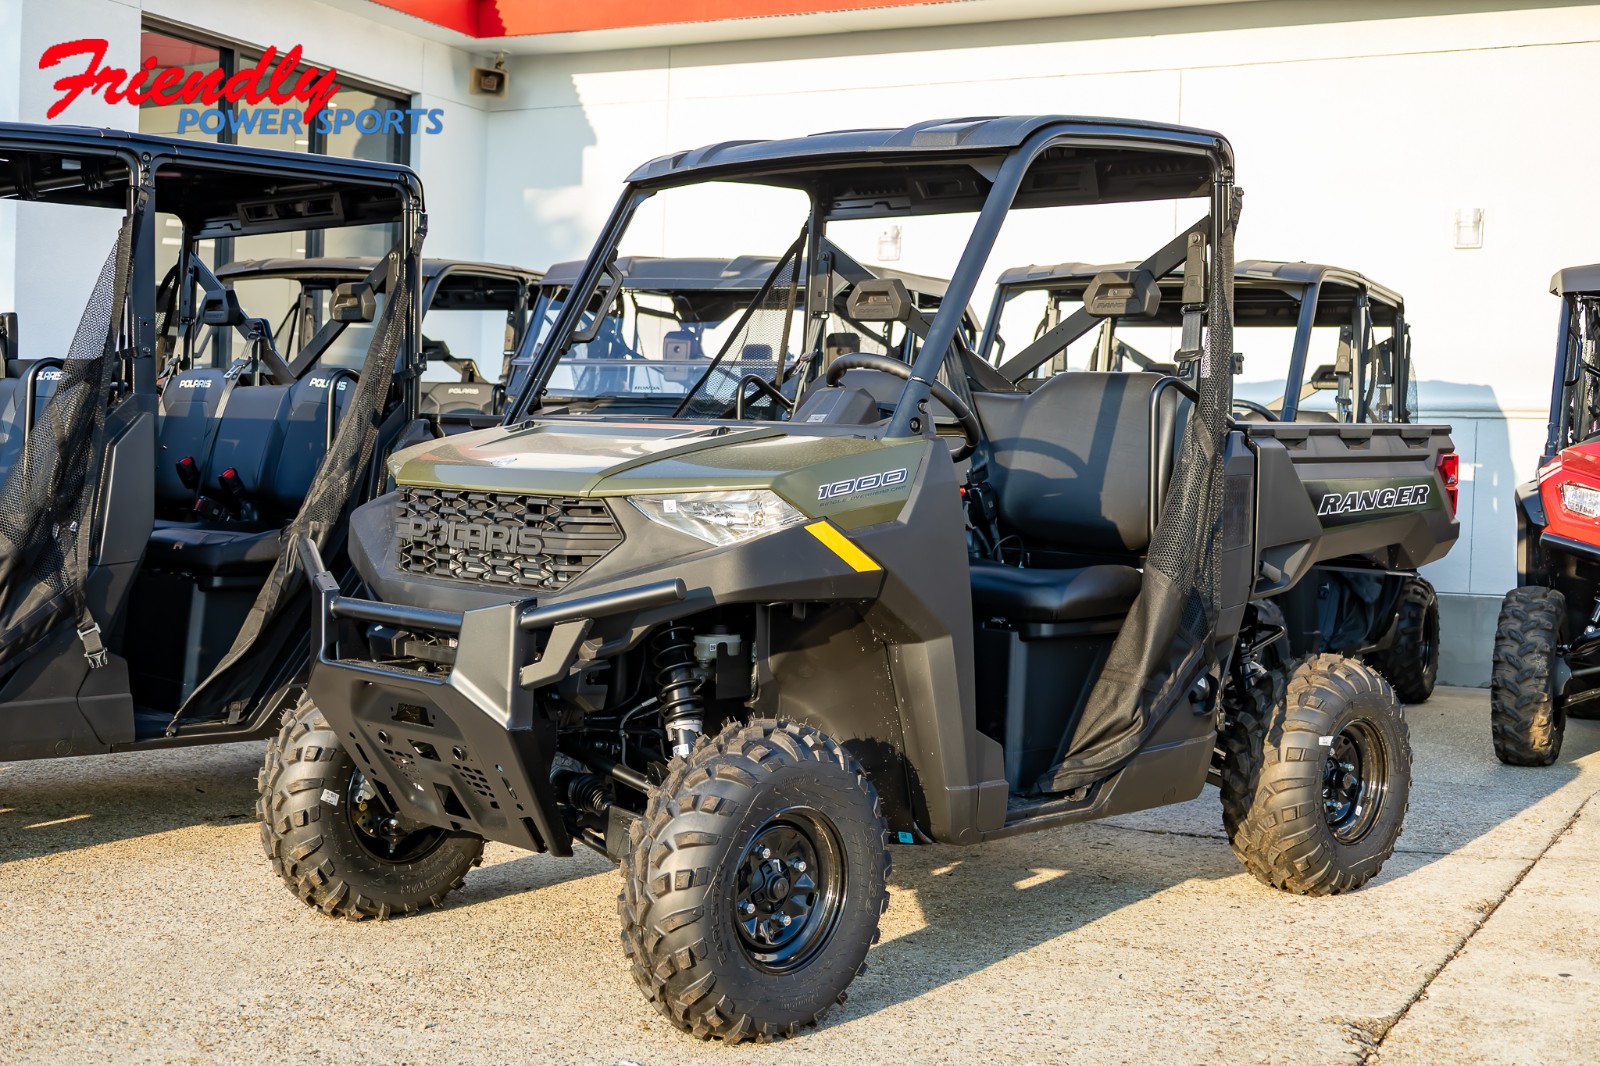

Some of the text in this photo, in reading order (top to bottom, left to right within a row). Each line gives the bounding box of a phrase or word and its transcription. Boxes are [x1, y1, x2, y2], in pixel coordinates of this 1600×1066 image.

[178, 379, 212, 389] POLARIS
[818, 468, 908, 499] 1000
[1316, 484, 1430, 516] RANGER
[408, 517, 546, 556] POLARIS
